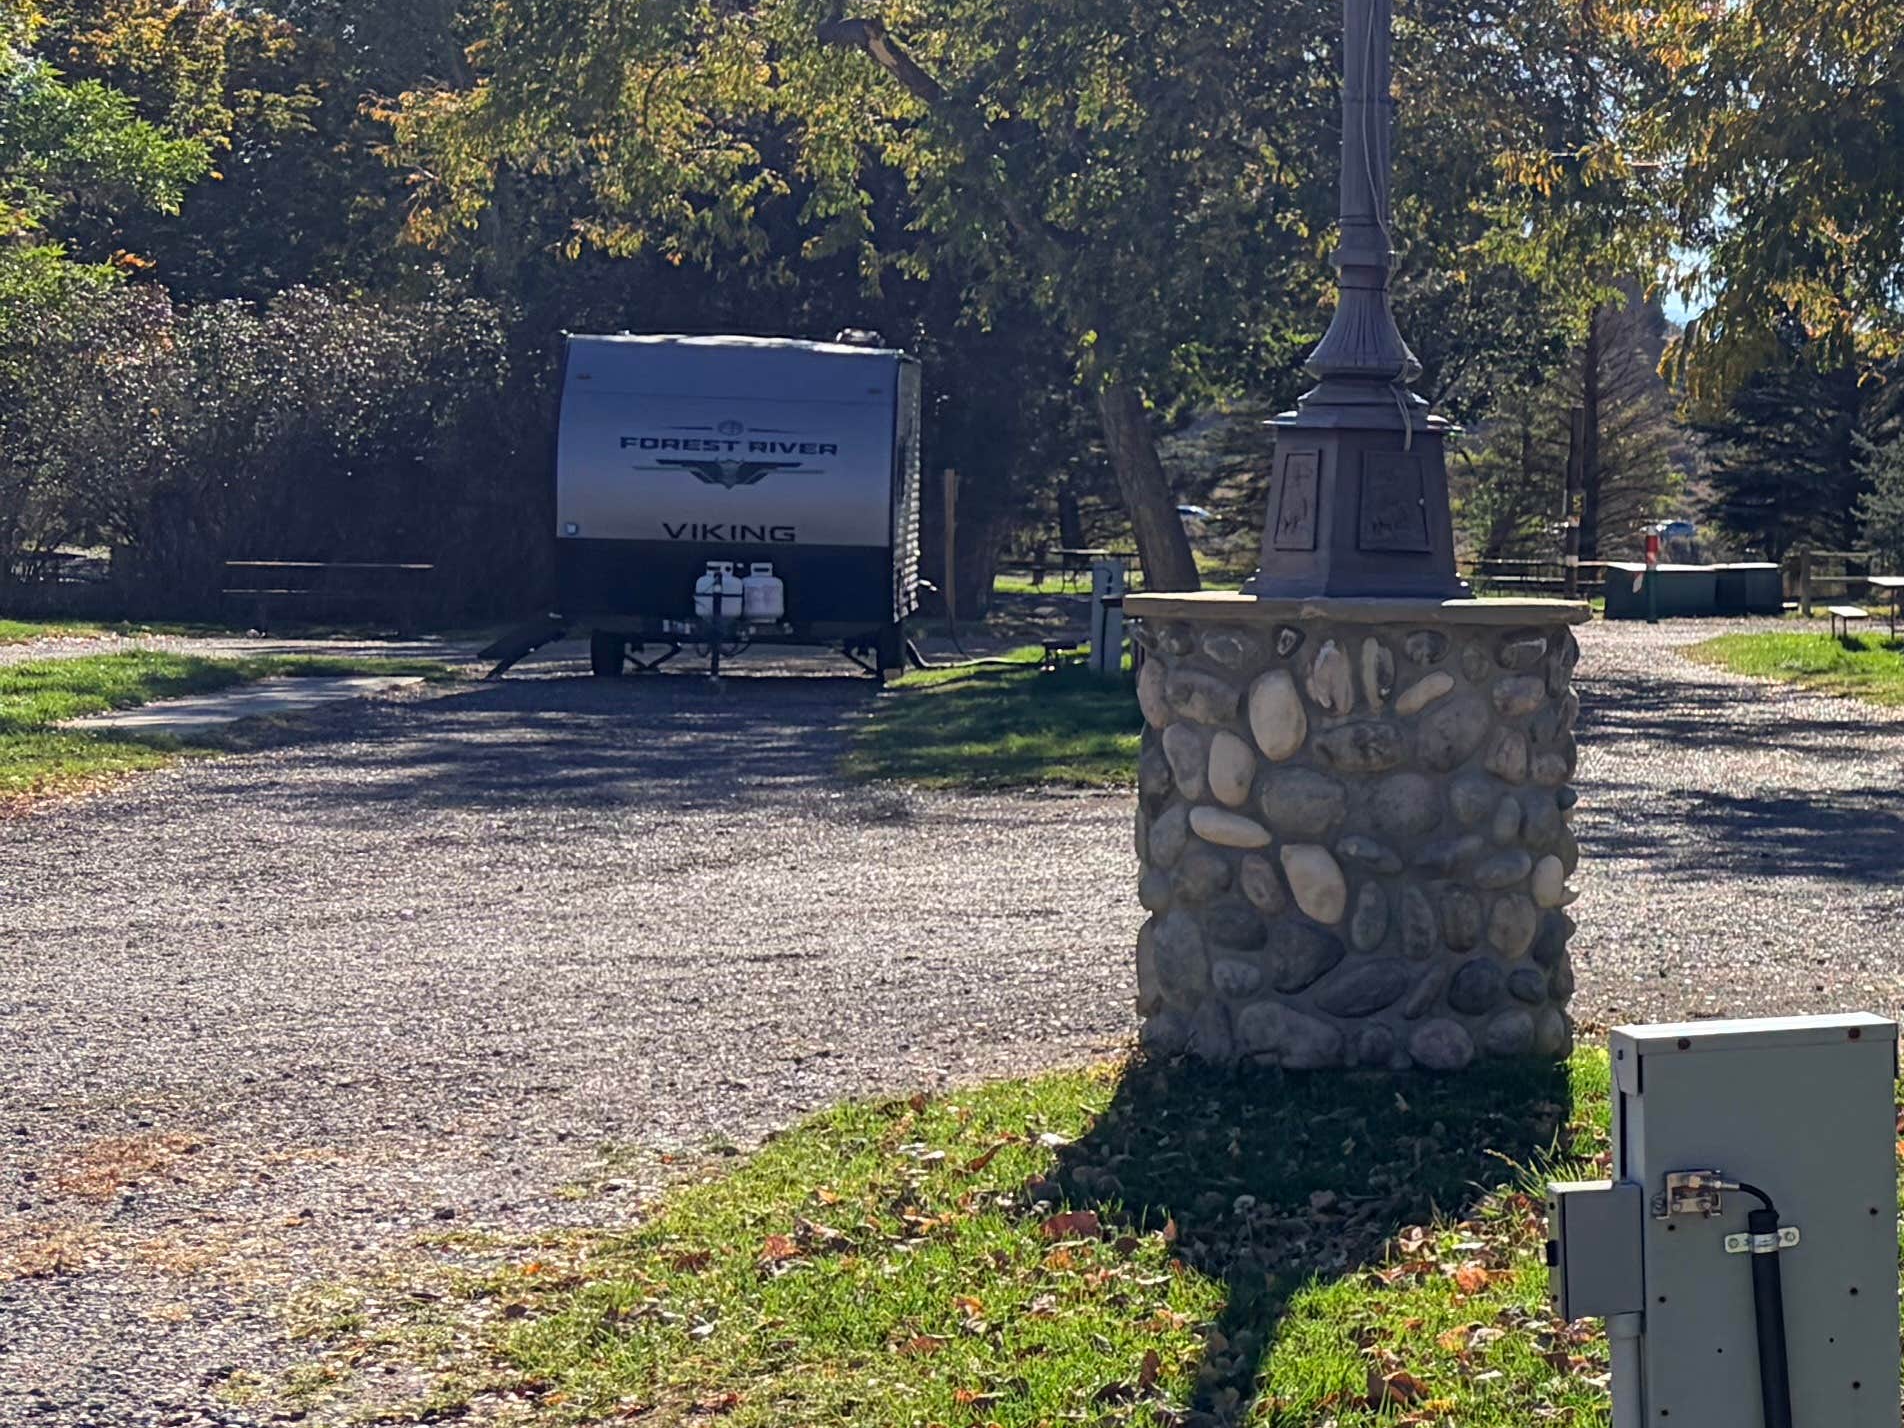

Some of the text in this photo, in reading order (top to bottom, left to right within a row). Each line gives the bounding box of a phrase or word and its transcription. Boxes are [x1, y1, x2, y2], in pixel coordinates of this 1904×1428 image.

[620, 436, 838, 456] FOREST RIVER
[662, 522, 796, 542] VIKING
